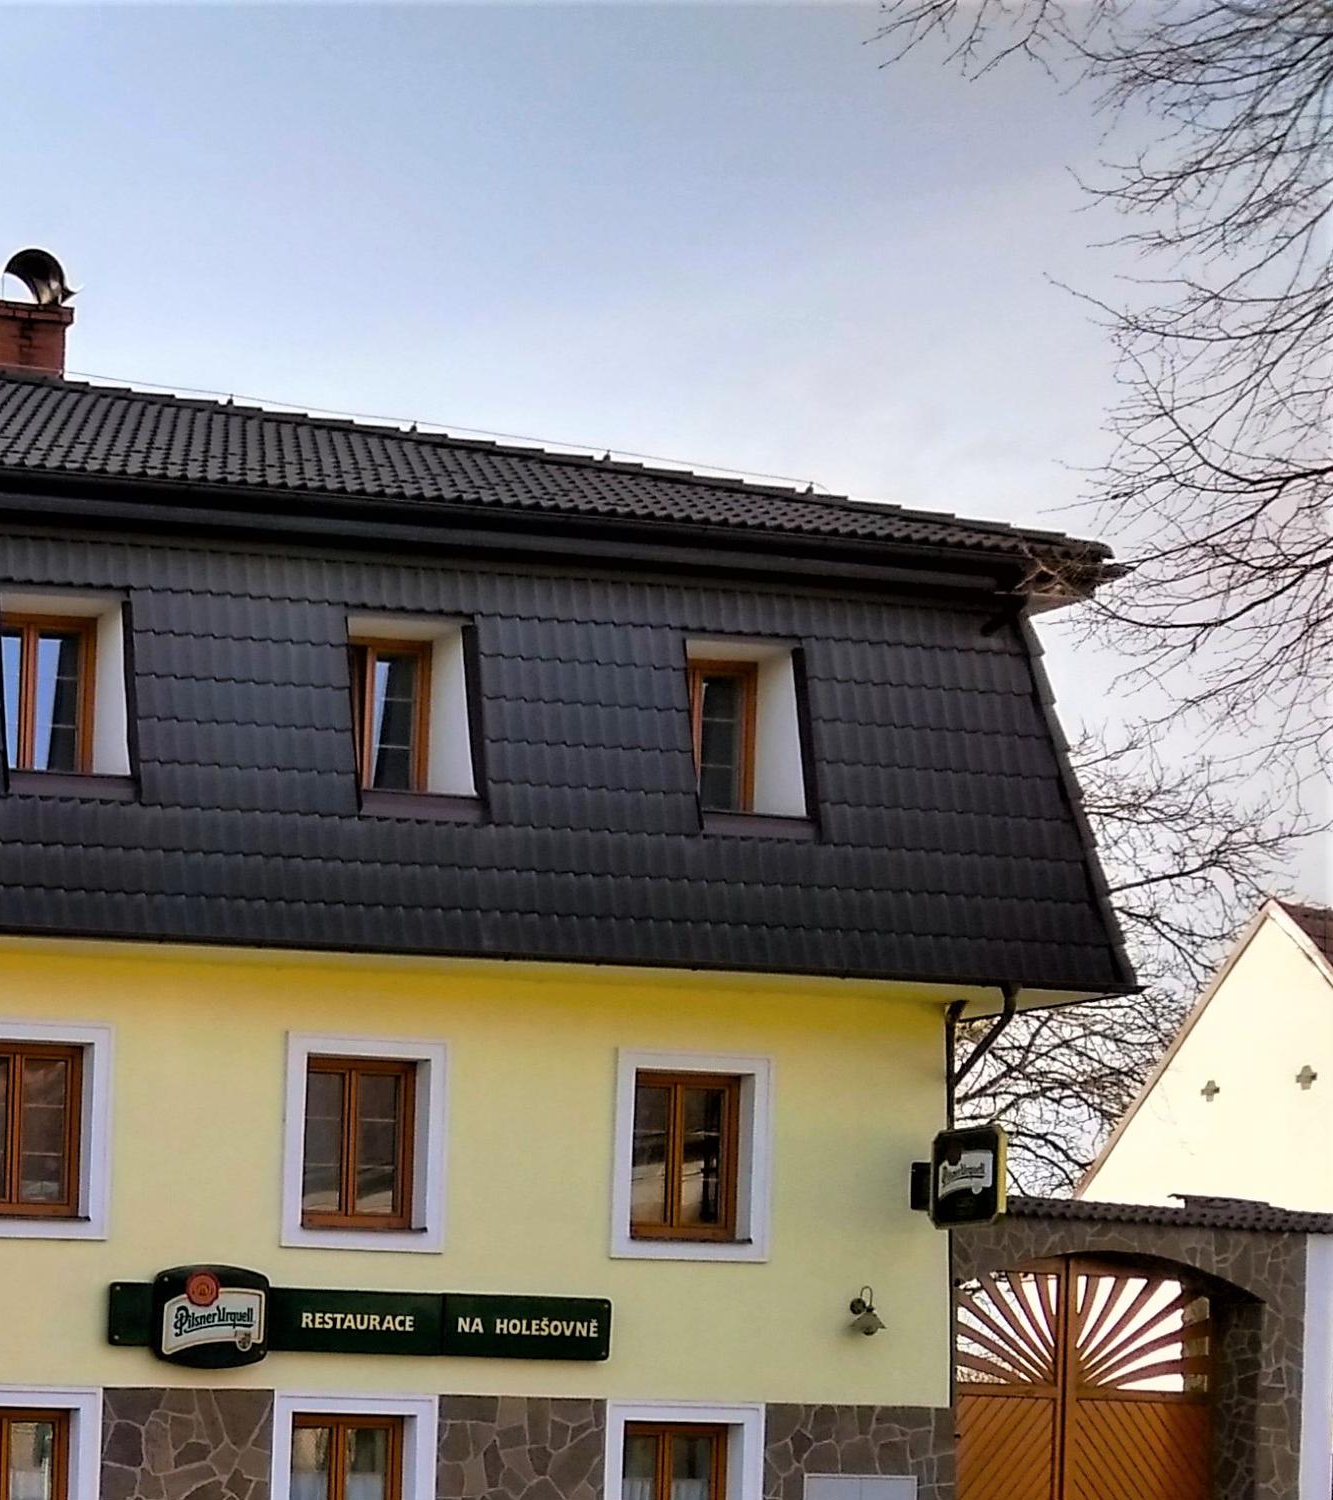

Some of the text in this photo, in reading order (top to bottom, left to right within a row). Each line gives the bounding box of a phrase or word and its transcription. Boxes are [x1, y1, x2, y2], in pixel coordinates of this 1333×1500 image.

[173, 1305, 253, 1337] Pilsner Urquell
[301, 1312, 599, 1338] RESTAURACE NA HOLEŠOVNĚ
